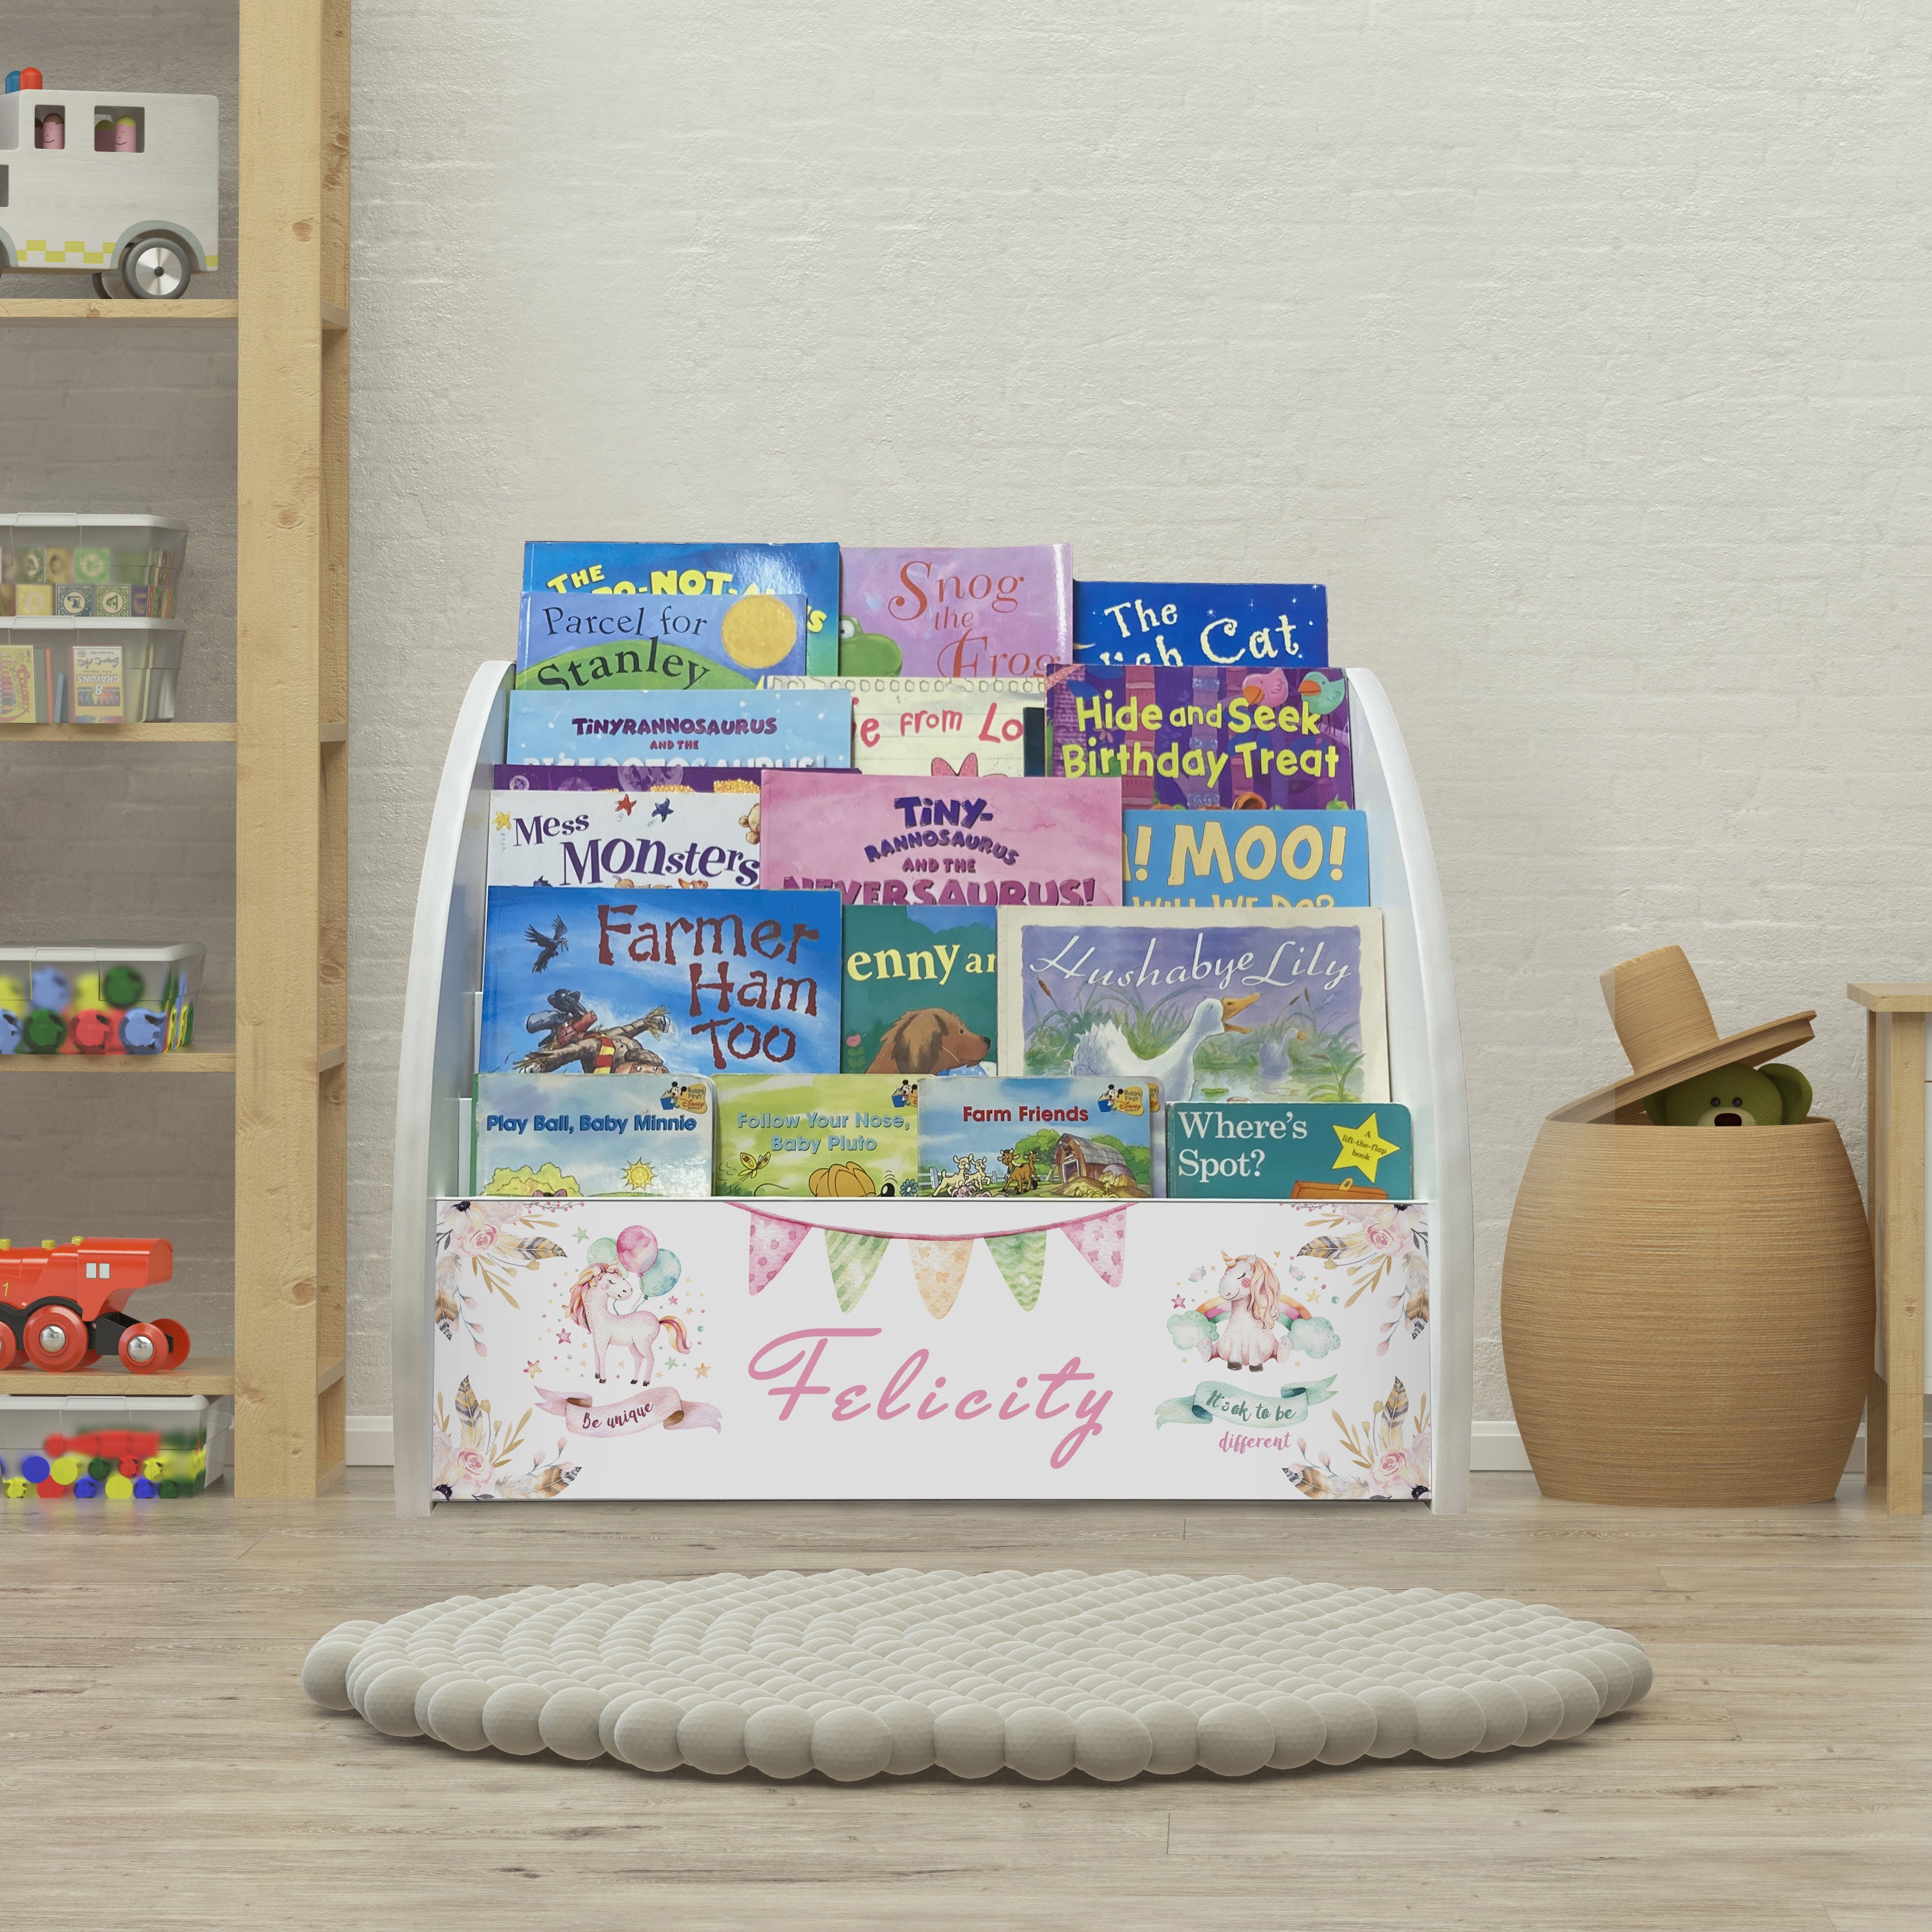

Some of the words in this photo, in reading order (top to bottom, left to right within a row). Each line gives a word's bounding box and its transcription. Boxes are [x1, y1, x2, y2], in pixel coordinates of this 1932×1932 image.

[547, 564, 605, 594] THE
[888, 561, 1025, 621] Snog
[543, 607, 645, 636] Parcel
[659, 606, 708, 636] for
[935, 606, 974, 631] the
[1104, 599, 1179, 638] The
[1200, 615, 1299, 664] Cat
[538, 636, 711, 690] Stanley
[76, 675, 120, 683] CRAYONS
[95, 684, 103, 695] 8
[900, 710, 963, 736] from
[1075, 690, 1163, 732] Hide
[1169, 703, 1222, 728] and
[1228, 698, 1320, 735] Seek
[650, 740, 674, 750] AND
[677, 740, 699, 750] THE
[1062, 736, 1229, 788] Birthday
[1235, 742, 1339, 778] Treat
[514, 813, 589, 847] Mess
[559, 836, 760, 887] Monsters
[864, 829, 1019, 865] RANNOSAURUS
[1167, 821, 1347, 886] MOO!
[902, 857, 939, 873] AND
[943, 857, 976, 873] THE
[598, 904, 819, 966] Farmer
[1030, 932, 1254, 990] Hushabye
[1241, 941, 1352, 990] Lily
[689, 961, 818, 1017] Ham
[487, 1115, 528, 1135] Play
[534, 1115, 574, 1134] Ball,
[580, 1115, 629, 1135] Baby
[634, 1115, 697, 1131] Minnie
[738, 1112, 799, 1129] Follow
[806, 1112, 849, 1128] Your
[855, 1112, 909, 1130] Nose,
[963, 1106, 1011, 1122] Farm
[1019, 1106, 1089, 1122] Friends
[1177, 1111, 1308, 1140] Where's
[771, 1135, 822, 1154] Baby
[828, 1135, 878, 1151] Pluto
[1342, 1135, 1387, 1155] lift-the-flap
[1352, 1149, 1370, 1161] book
[1179, 1149, 1265, 1183] Spot?
[748, 1327, 1114, 1469] Felicity
[1231, 1401, 1252, 1422] ok
[1256, 1403, 1271, 1419] to
[1275, 1405, 1296, 1421] be
[582, 1411, 603, 1429] Be
[607, 1403, 654, 1428] unique
[1219, 1431, 1292, 1454] different
